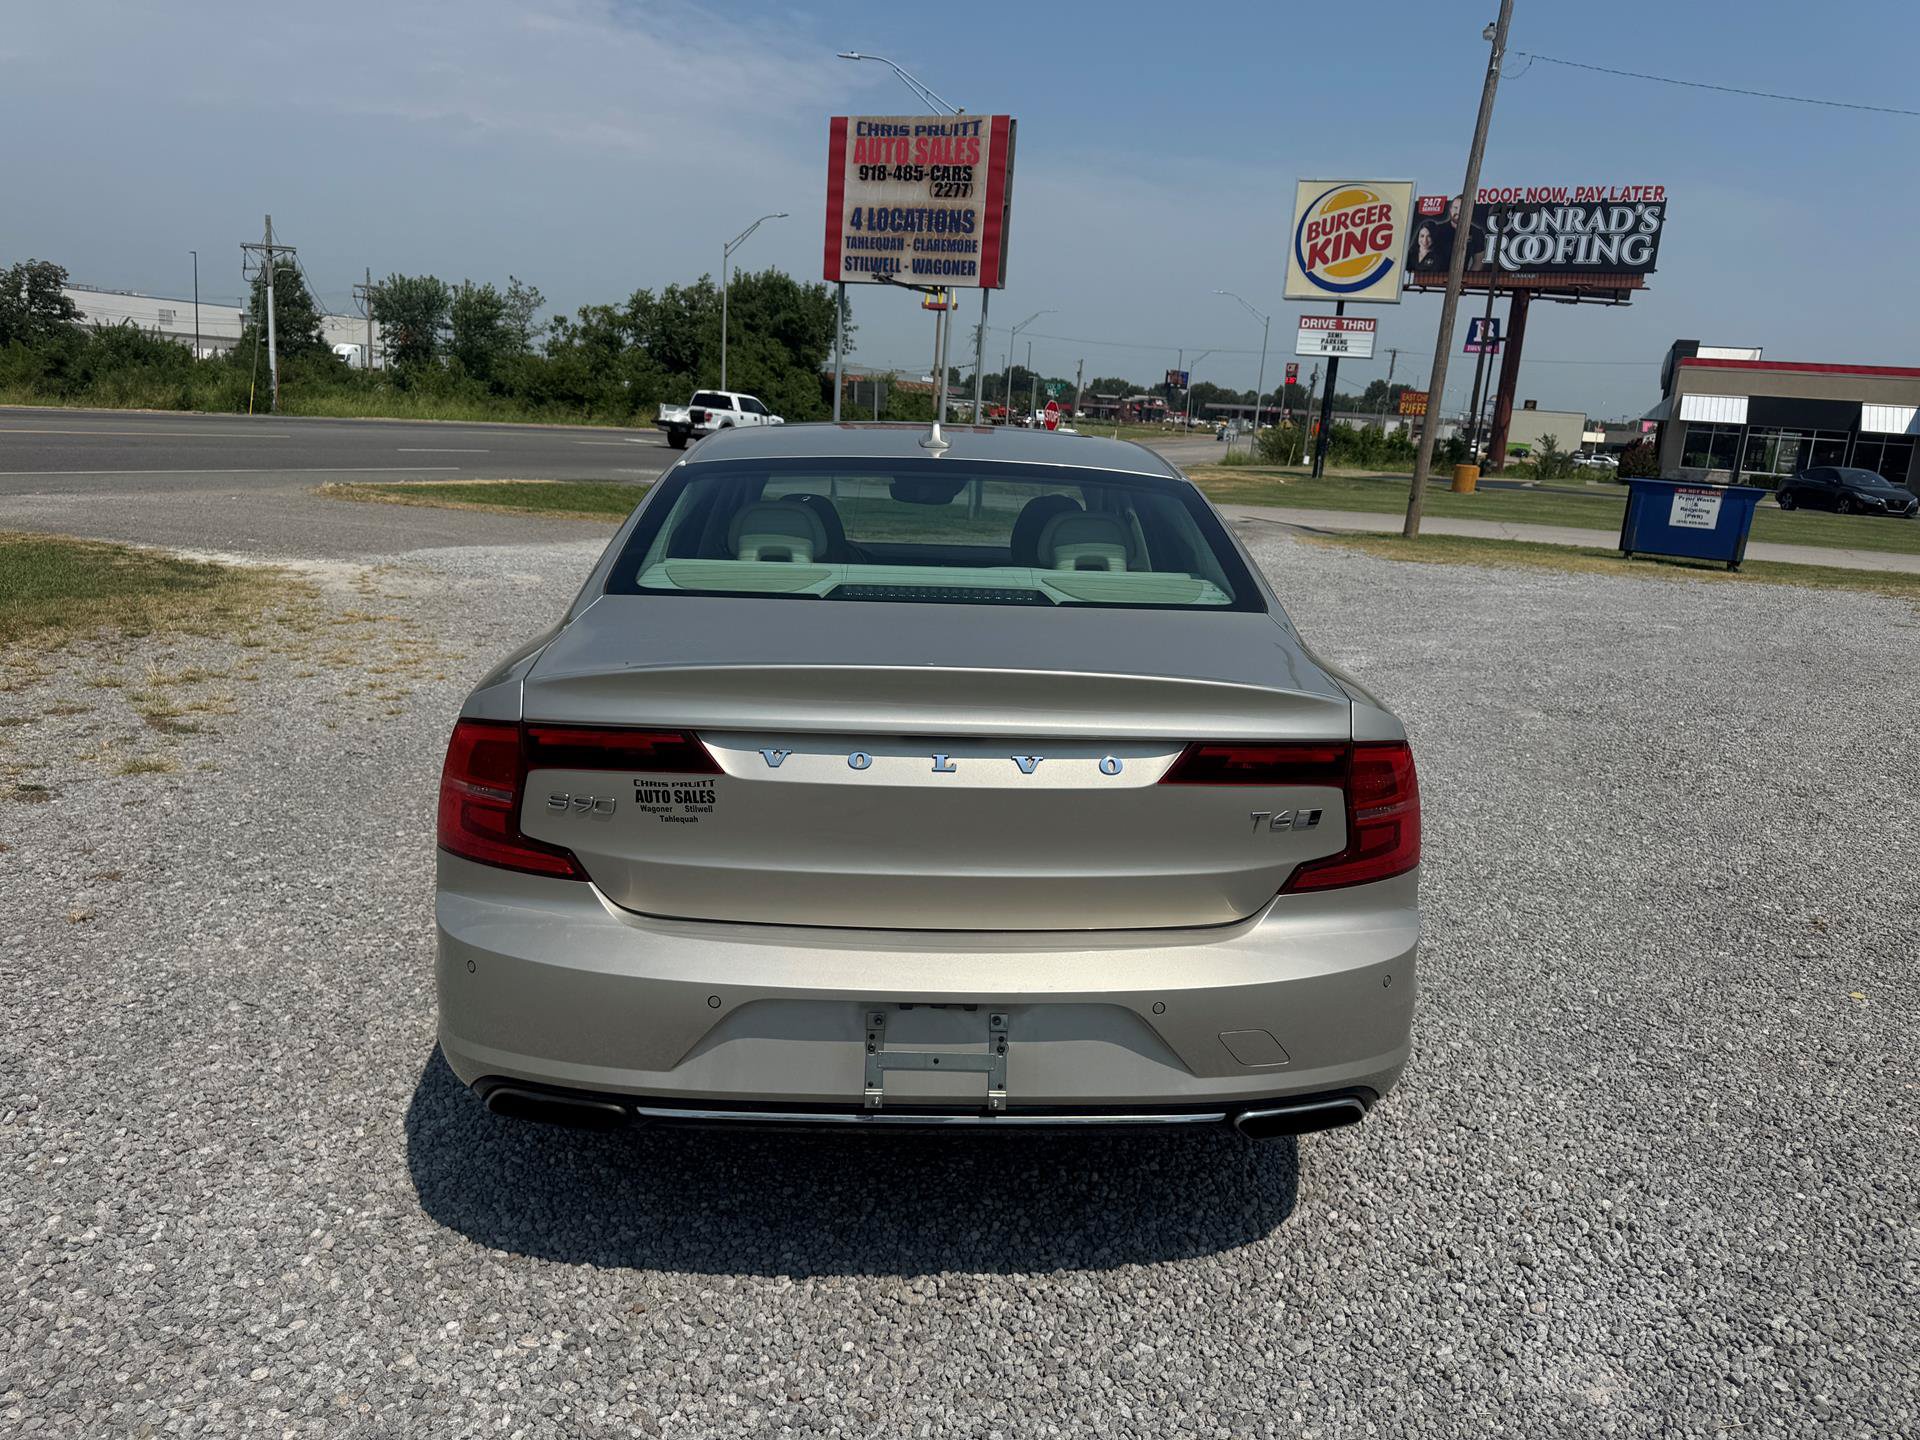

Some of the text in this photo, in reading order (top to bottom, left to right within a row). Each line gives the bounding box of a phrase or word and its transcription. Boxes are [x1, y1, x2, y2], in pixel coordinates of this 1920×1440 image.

[856, 120, 983, 137] CHRIS PRUITT
[853, 137, 980, 166] AUTO SALES
[859, 165, 973, 182] 918-485-CARS
[929, 182, 974, 198] (2277)
[1476, 185, 1665, 205] ROOF NOW, PAY LATER
[1424, 198, 1442, 207] 24/7
[850, 207, 975, 233] 4 LOCATIONS
[1306, 204, 1393, 243] BURGER
[845, 236, 904, 251] TAHLEQUAH
[913, 238, 978, 253] CLAREMORE
[1306, 223, 1394, 271] KING
[1482, 233, 1654, 271] ROOFING
[844, 256, 902, 273] STILWELL
[912, 258, 977, 276] WAGONER
[1301, 318, 1375, 330] DRIVE THRU
[1045, 410, 1058, 422] STOP
[1400, 402, 1427, 414] BUFFE
[759, 749, 1123, 776] VOLVO
[633, 779, 716, 788] CHRIS PRUITT
[548, 792, 616, 816] S90
[635, 789, 716, 804] AUTO SALES
[640, 804, 713, 814] Wagoner Stilwell
[659, 815, 699, 824] Tahlequah
